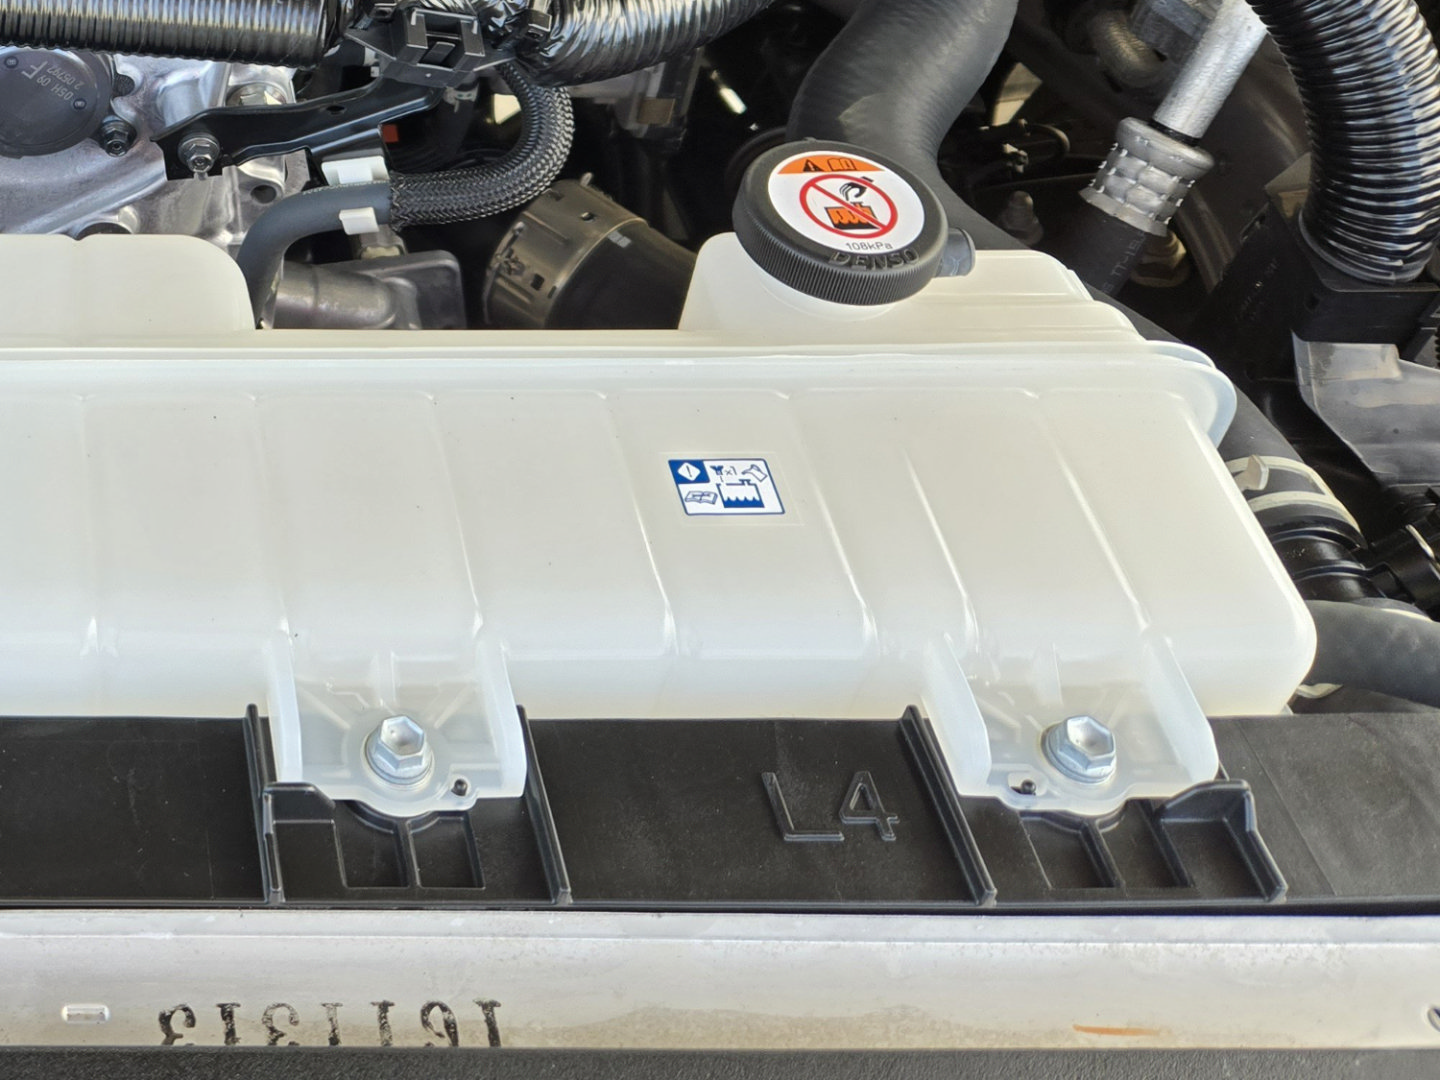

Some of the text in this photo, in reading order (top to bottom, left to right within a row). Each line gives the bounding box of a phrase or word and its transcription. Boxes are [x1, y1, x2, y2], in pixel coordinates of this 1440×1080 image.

[21, 60, 47, 80] F
[36, 73, 51, 87] 09
[845, 241, 893, 252] 108kPa
[828, 250, 920, 270] DENSO
[761, 771, 900, 842] L4
